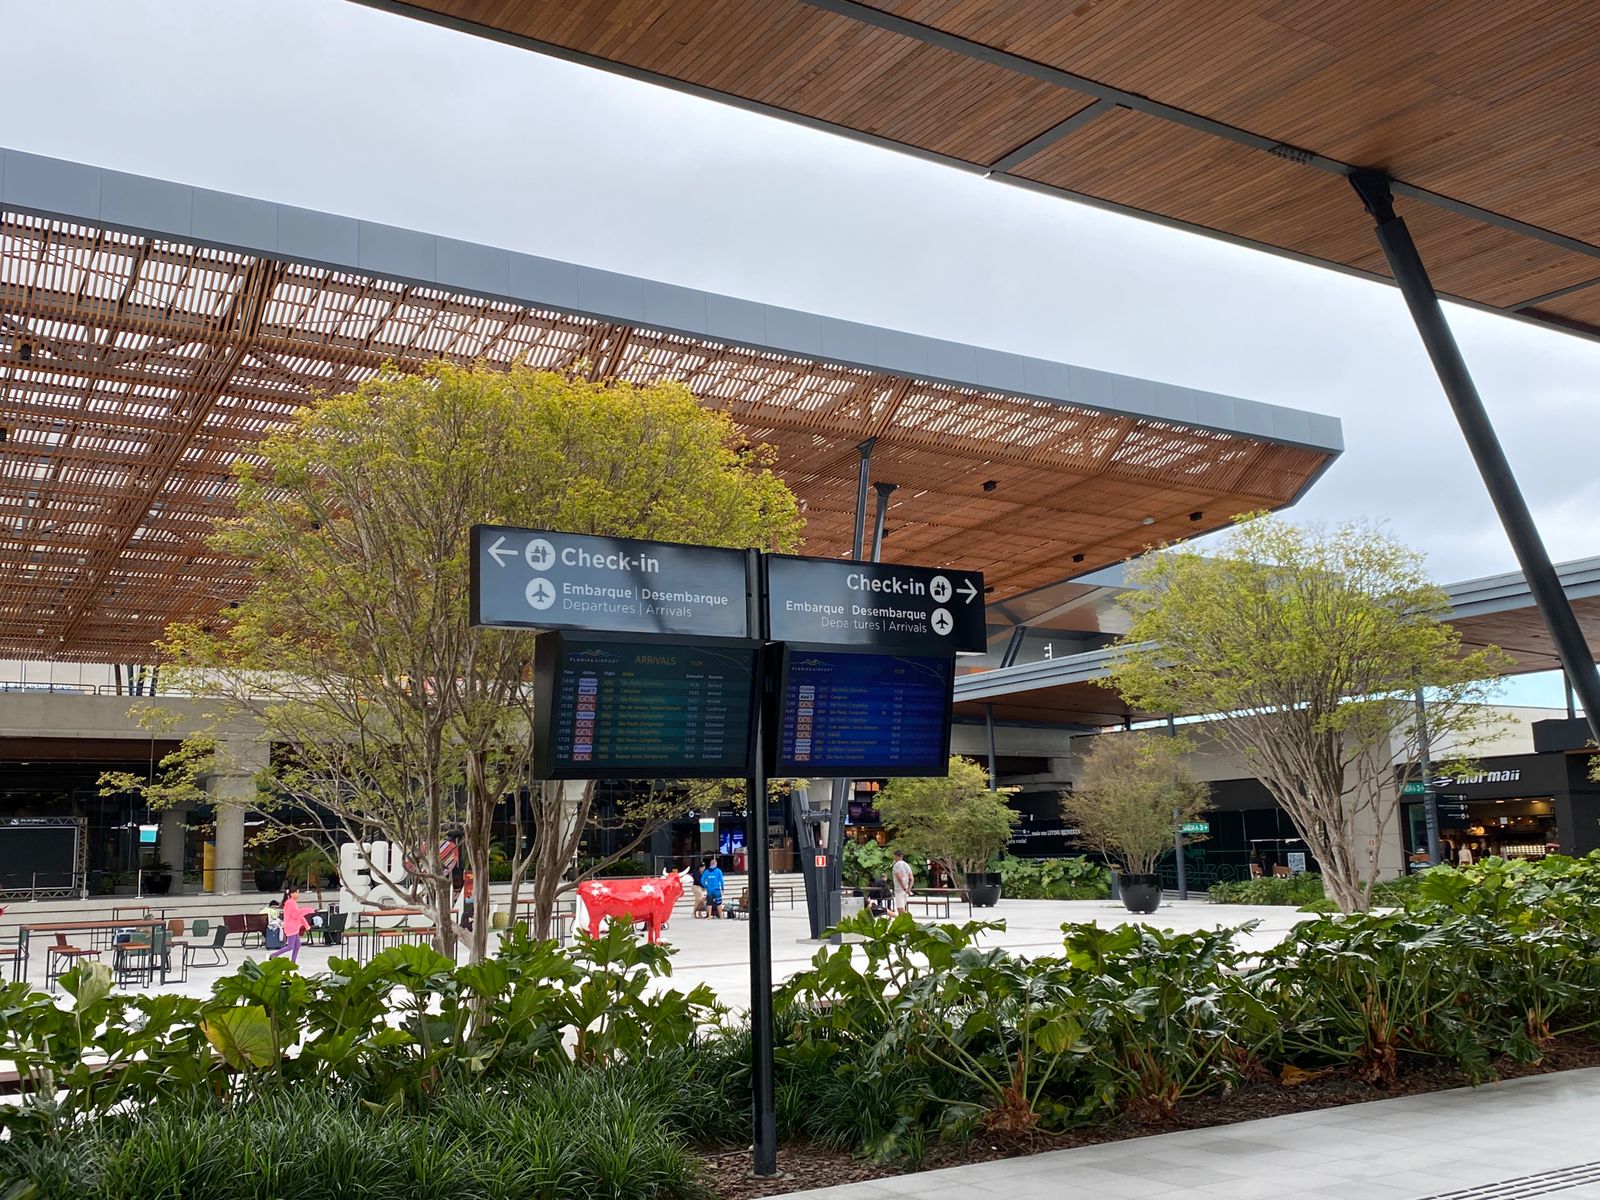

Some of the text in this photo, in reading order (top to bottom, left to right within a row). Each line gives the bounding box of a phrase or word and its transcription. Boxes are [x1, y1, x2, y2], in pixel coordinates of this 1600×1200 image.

[561, 548, 659, 574] Check-in
[563, 583, 729, 606] Embarque Desembarque
[846, 573, 925, 596] Check-in
[563, 598, 693, 618] Departures Arrivals
[785, 600, 927, 621] Embarque Desembarque
[821, 616, 927, 634] Depatures Arrivals
[634, 656, 677, 667] ARRIVALS
[341, 840, 411, 887] EU
